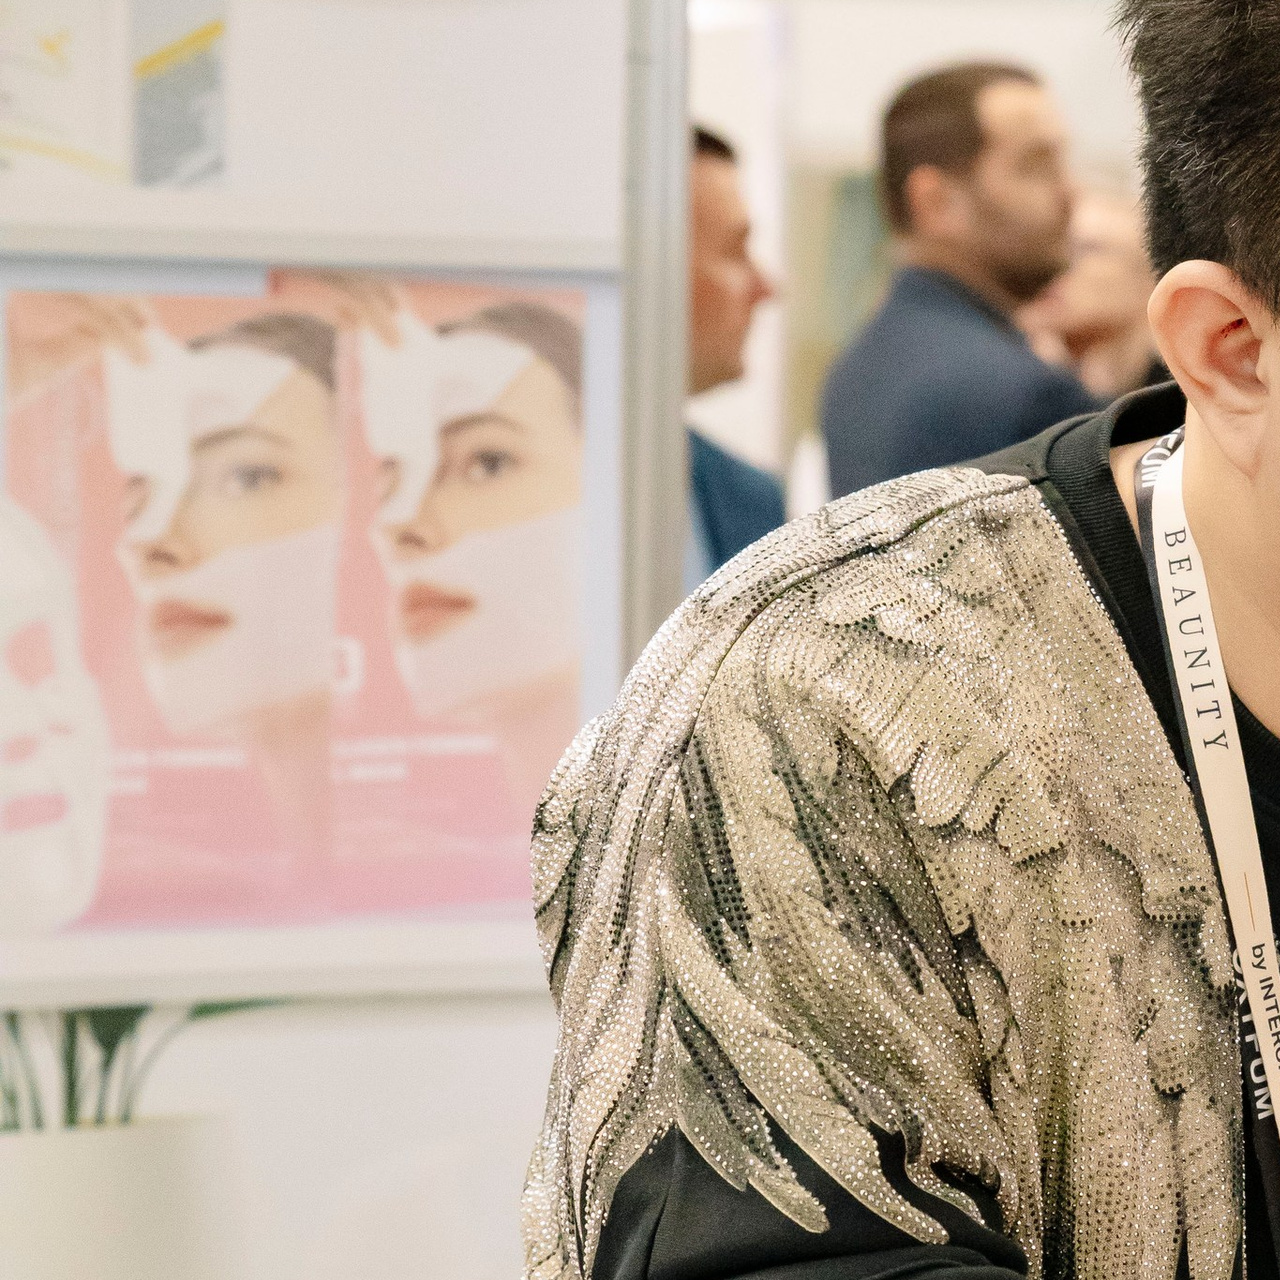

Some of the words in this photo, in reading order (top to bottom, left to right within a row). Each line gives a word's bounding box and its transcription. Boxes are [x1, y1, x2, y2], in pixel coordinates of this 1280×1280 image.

[1141, 423, 1186, 488] FUM
[1163, 526, 1229, 752] BEAUNITY
[1251, 942, 1268, 971] by
